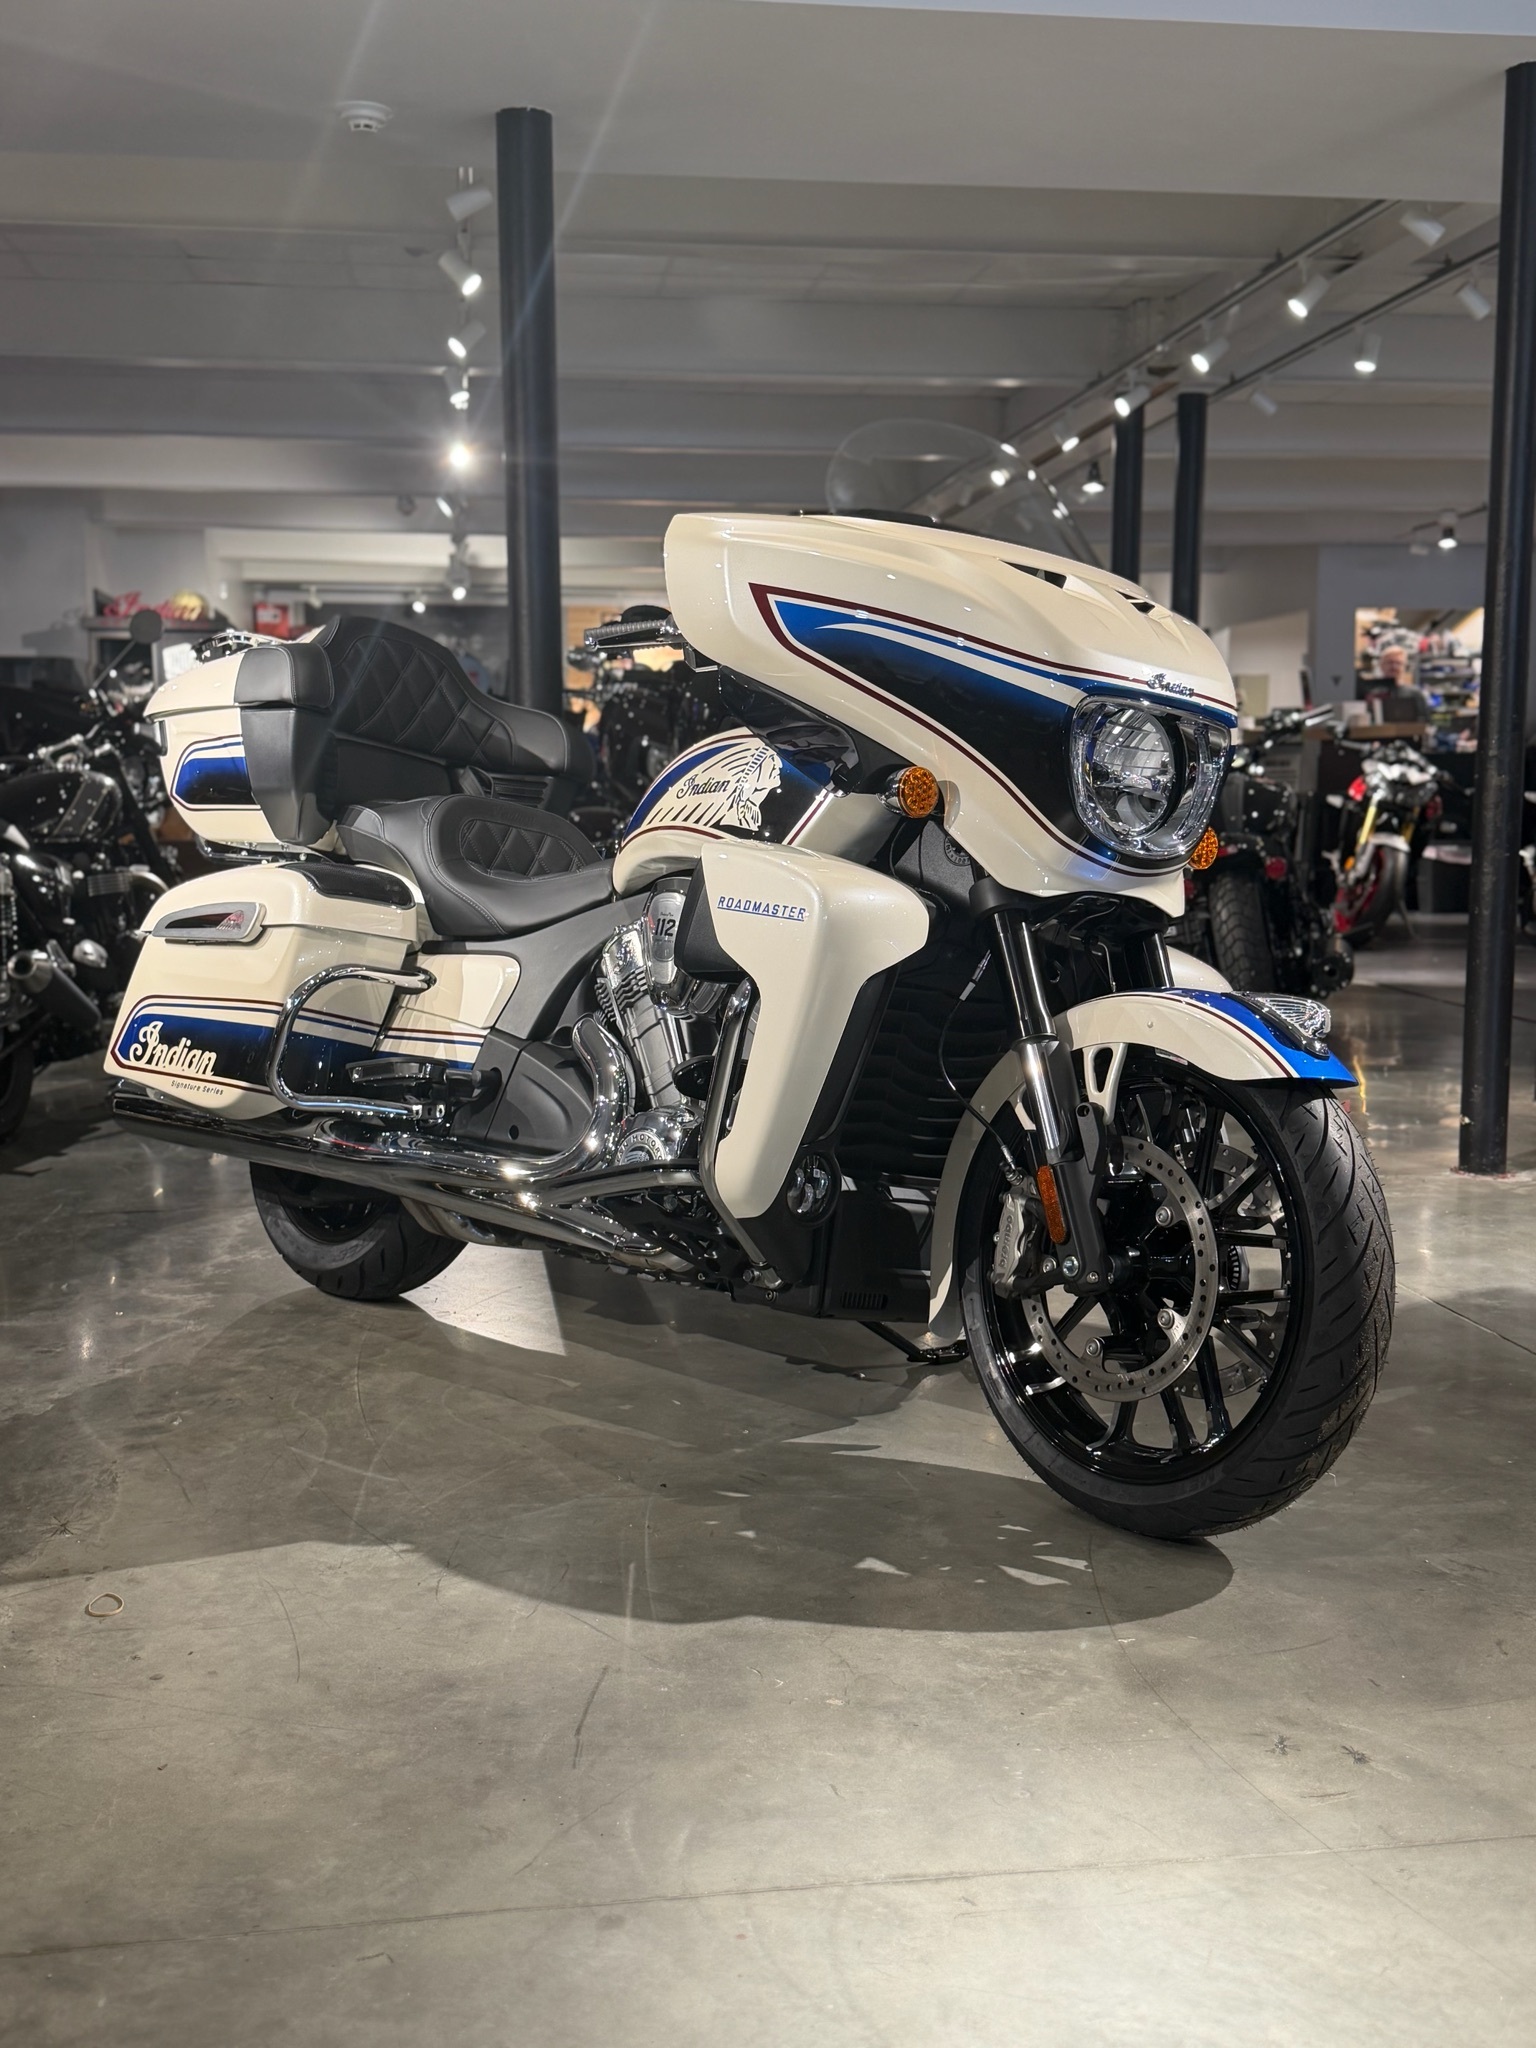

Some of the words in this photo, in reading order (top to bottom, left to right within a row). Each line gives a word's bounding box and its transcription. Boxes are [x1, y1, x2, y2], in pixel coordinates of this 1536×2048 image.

[676, 774, 731, 799] Indian
[717, 896, 807, 920] ROADMASTER
[655, 918, 676, 937] 112
[129, 1020, 217, 1076] Indian
[171, 1080, 201, 1092] Signature
[202, 1085, 224, 1096] Series
[998, 1214, 1015, 1268] brembo
